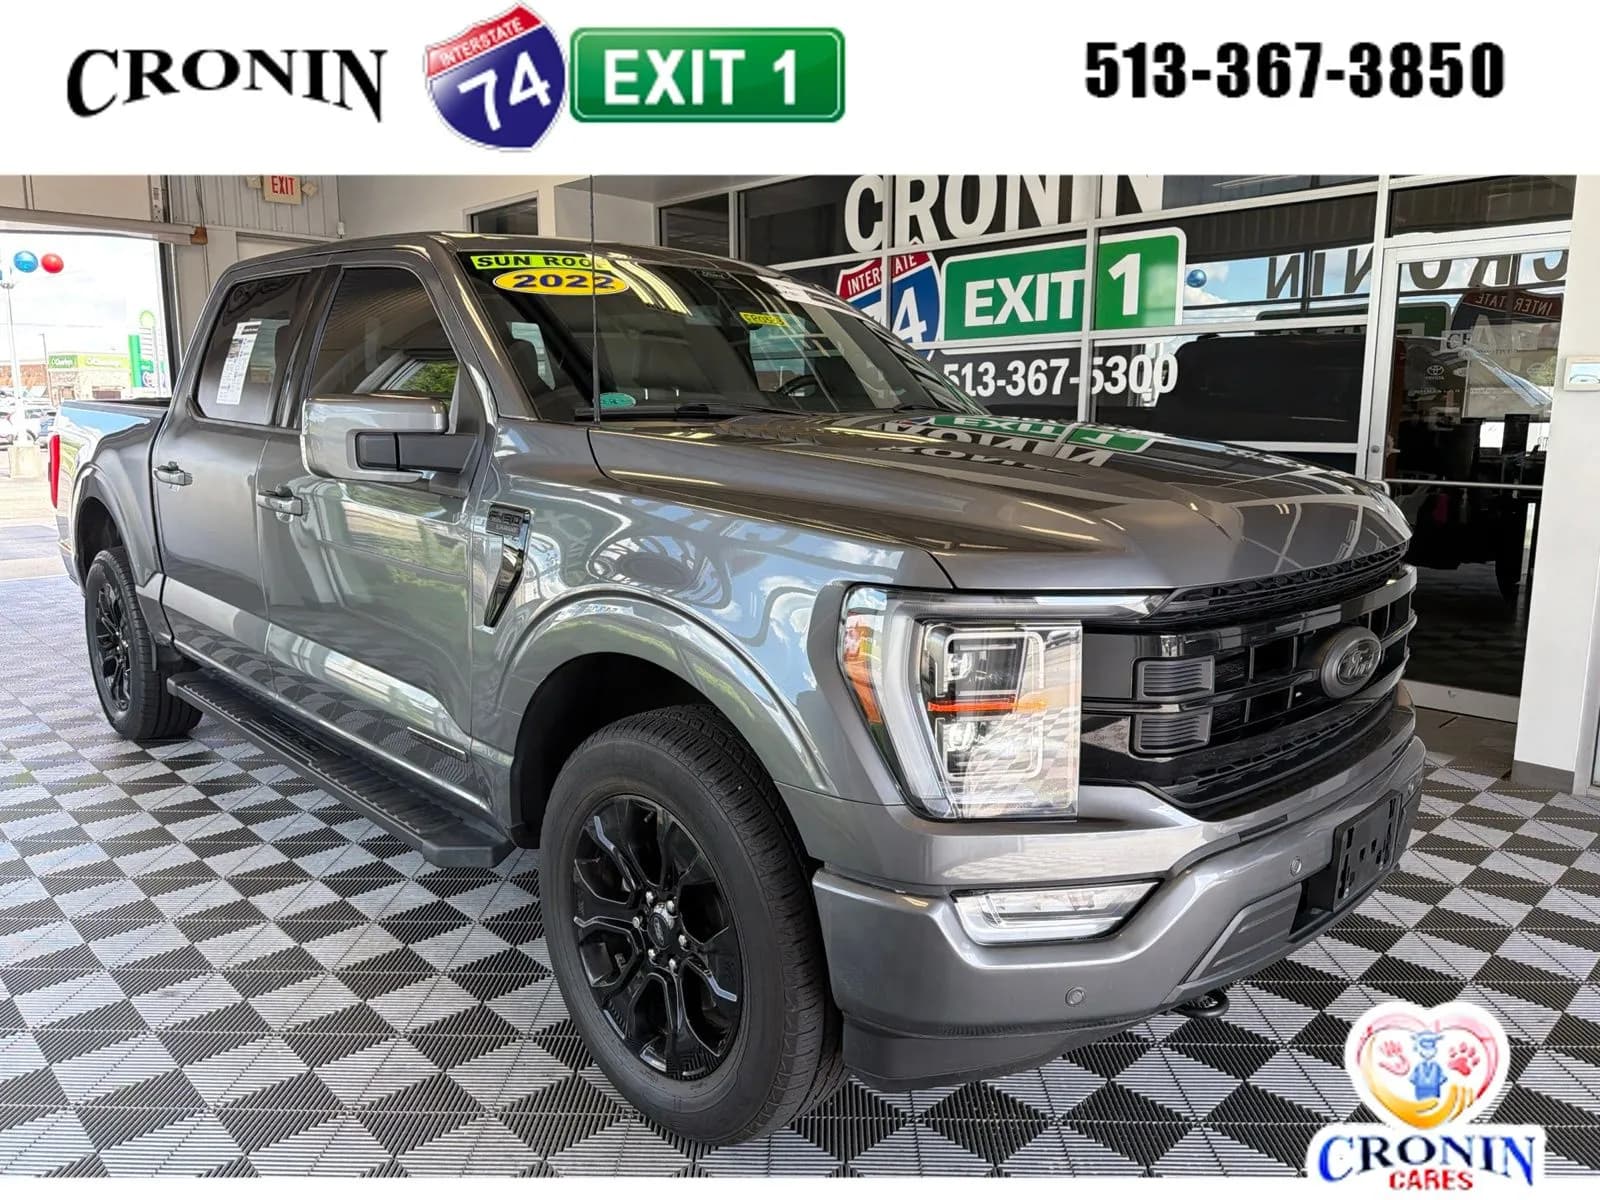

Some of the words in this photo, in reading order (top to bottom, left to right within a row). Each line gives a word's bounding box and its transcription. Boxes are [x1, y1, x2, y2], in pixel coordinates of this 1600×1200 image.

[271, 175, 296, 196] EXIT
[844, 175, 1163, 253] CRONIN
[477, 255, 531, 268] SUN
[542, 256, 606, 269] ROO
[512, 273, 615, 289] 2022
[847, 254, 918, 296] INTERATE
[964, 269, 1085, 328] EXIT
[1108, 253, 1141, 316] 1
[943, 352, 1179, 398] 513-367-5300
